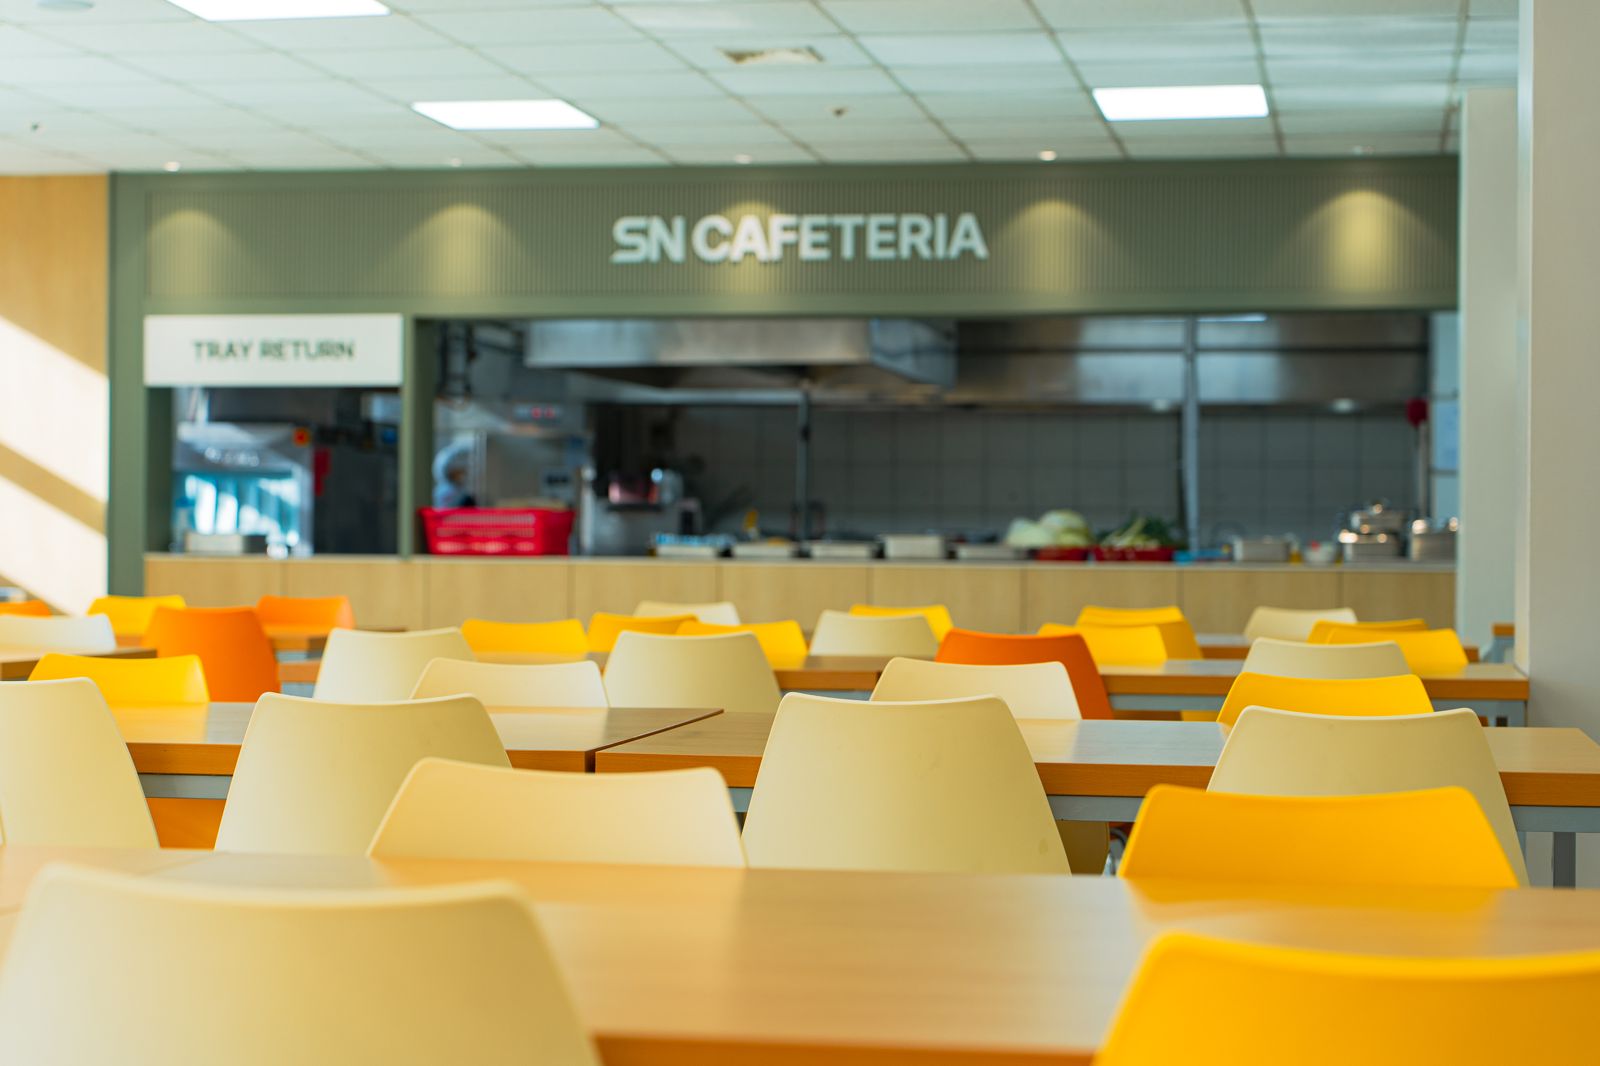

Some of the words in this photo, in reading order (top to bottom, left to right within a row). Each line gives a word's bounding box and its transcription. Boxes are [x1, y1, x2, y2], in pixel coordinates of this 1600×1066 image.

[610, 215, 685, 263] SN
[692, 213, 989, 262] CAFETERIA
[193, 340, 252, 361] TRAY
[260, 339, 355, 361] RETURN
